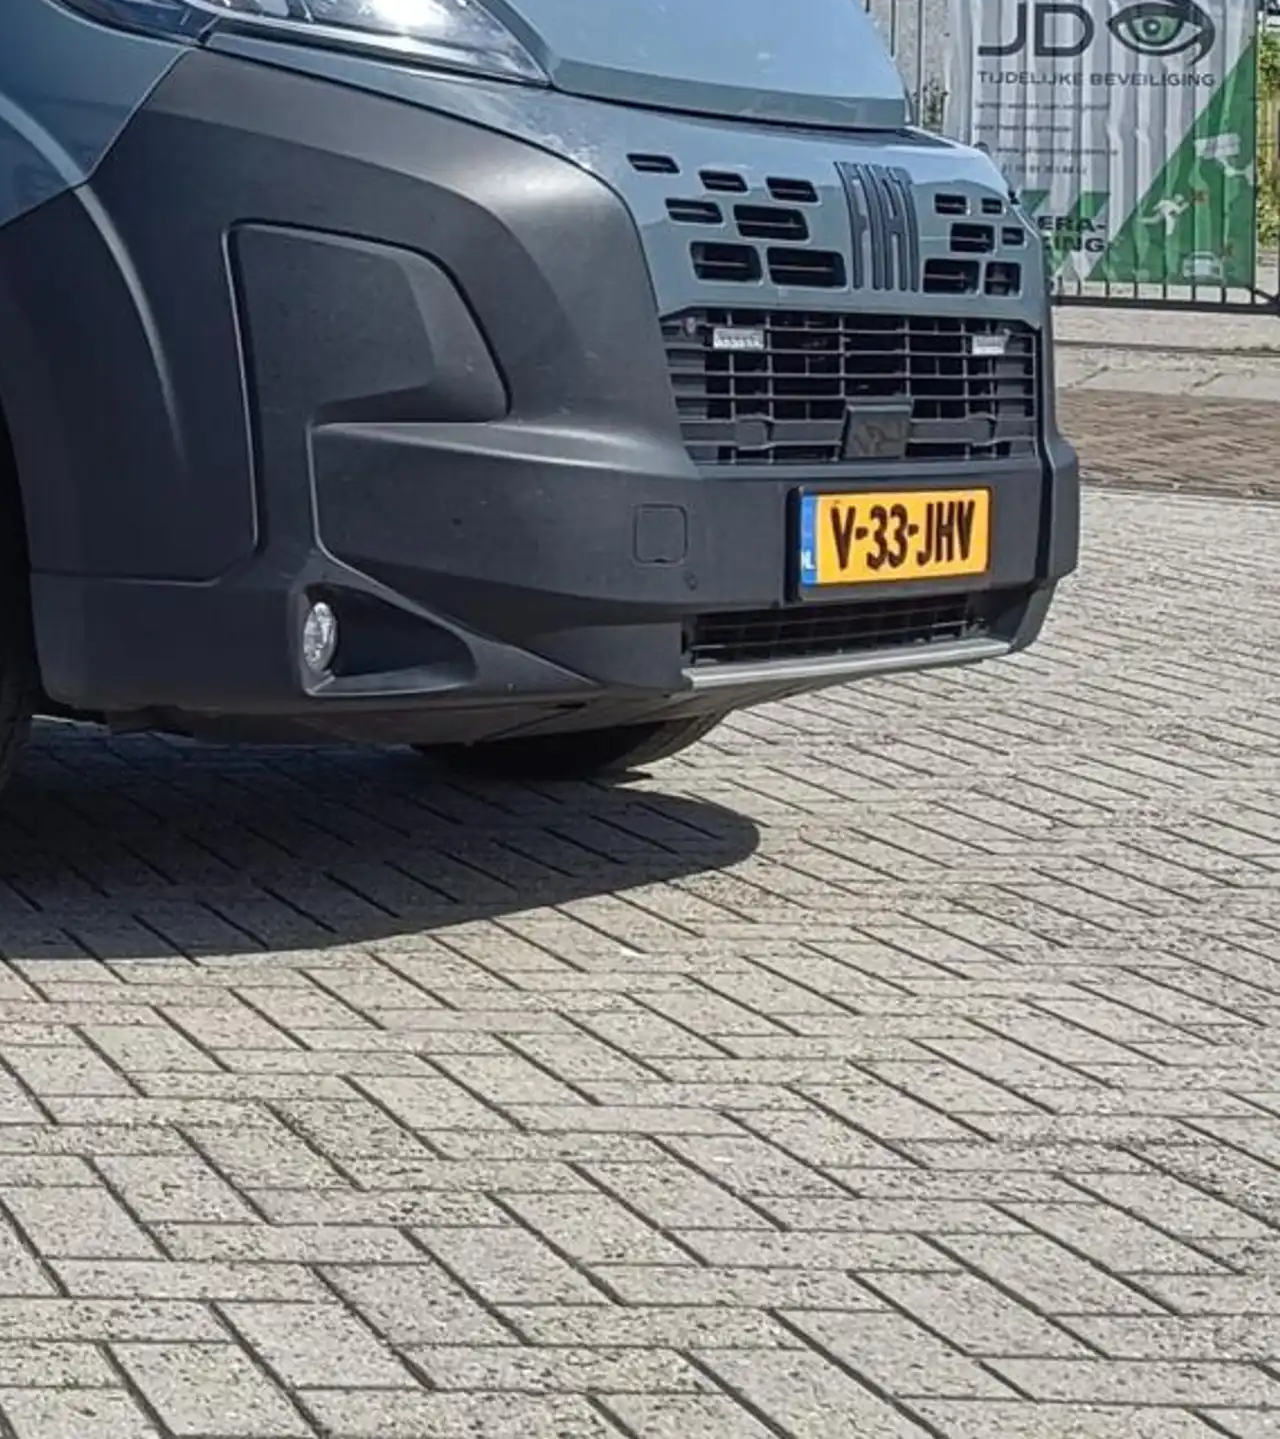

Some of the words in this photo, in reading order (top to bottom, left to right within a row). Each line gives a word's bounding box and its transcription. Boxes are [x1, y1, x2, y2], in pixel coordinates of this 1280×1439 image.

[977, 3, 1094, 57] JD
[977, 71, 1083, 85] TIJDELIJKE
[1090, 72, 1216, 86] BEVEILIGING
[833, 161, 919, 292] FIAT
[830, 500, 976, 571] V-33-JHV
